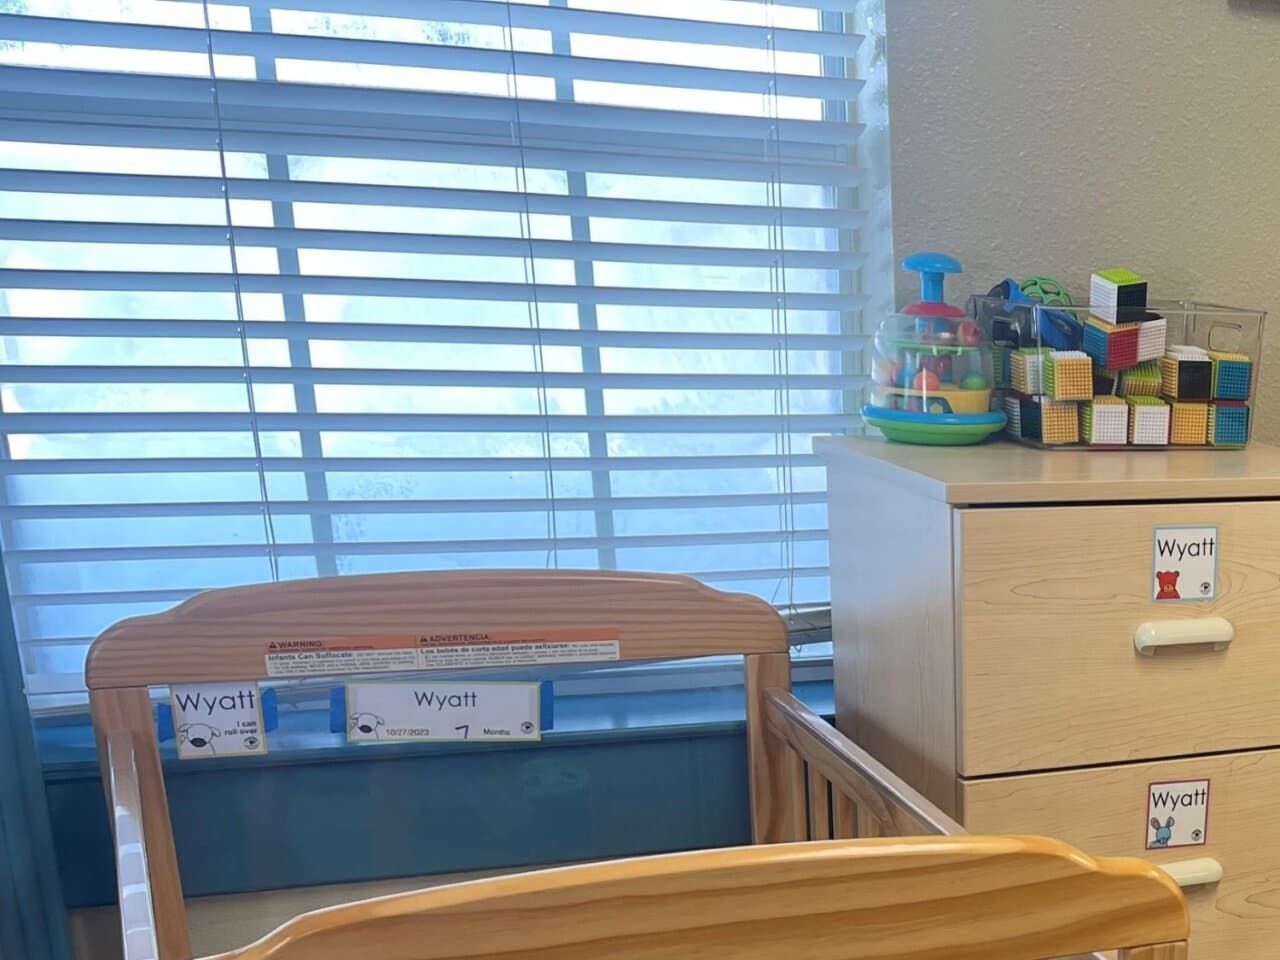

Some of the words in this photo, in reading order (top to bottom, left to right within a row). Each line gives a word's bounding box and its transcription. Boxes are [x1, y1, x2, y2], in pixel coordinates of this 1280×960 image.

[1157, 537, 1215, 562] Wyatt
[175, 689, 255, 716] Wyatt
[414, 691, 477, 711] Wyatt
[224, 728, 238, 736] roll
[386, 728, 429, 737] 10/27/2023
[454, 724, 469, 739] 7
[483, 728, 510, 736] Months
[1152, 788, 1206, 812] Wyatt
